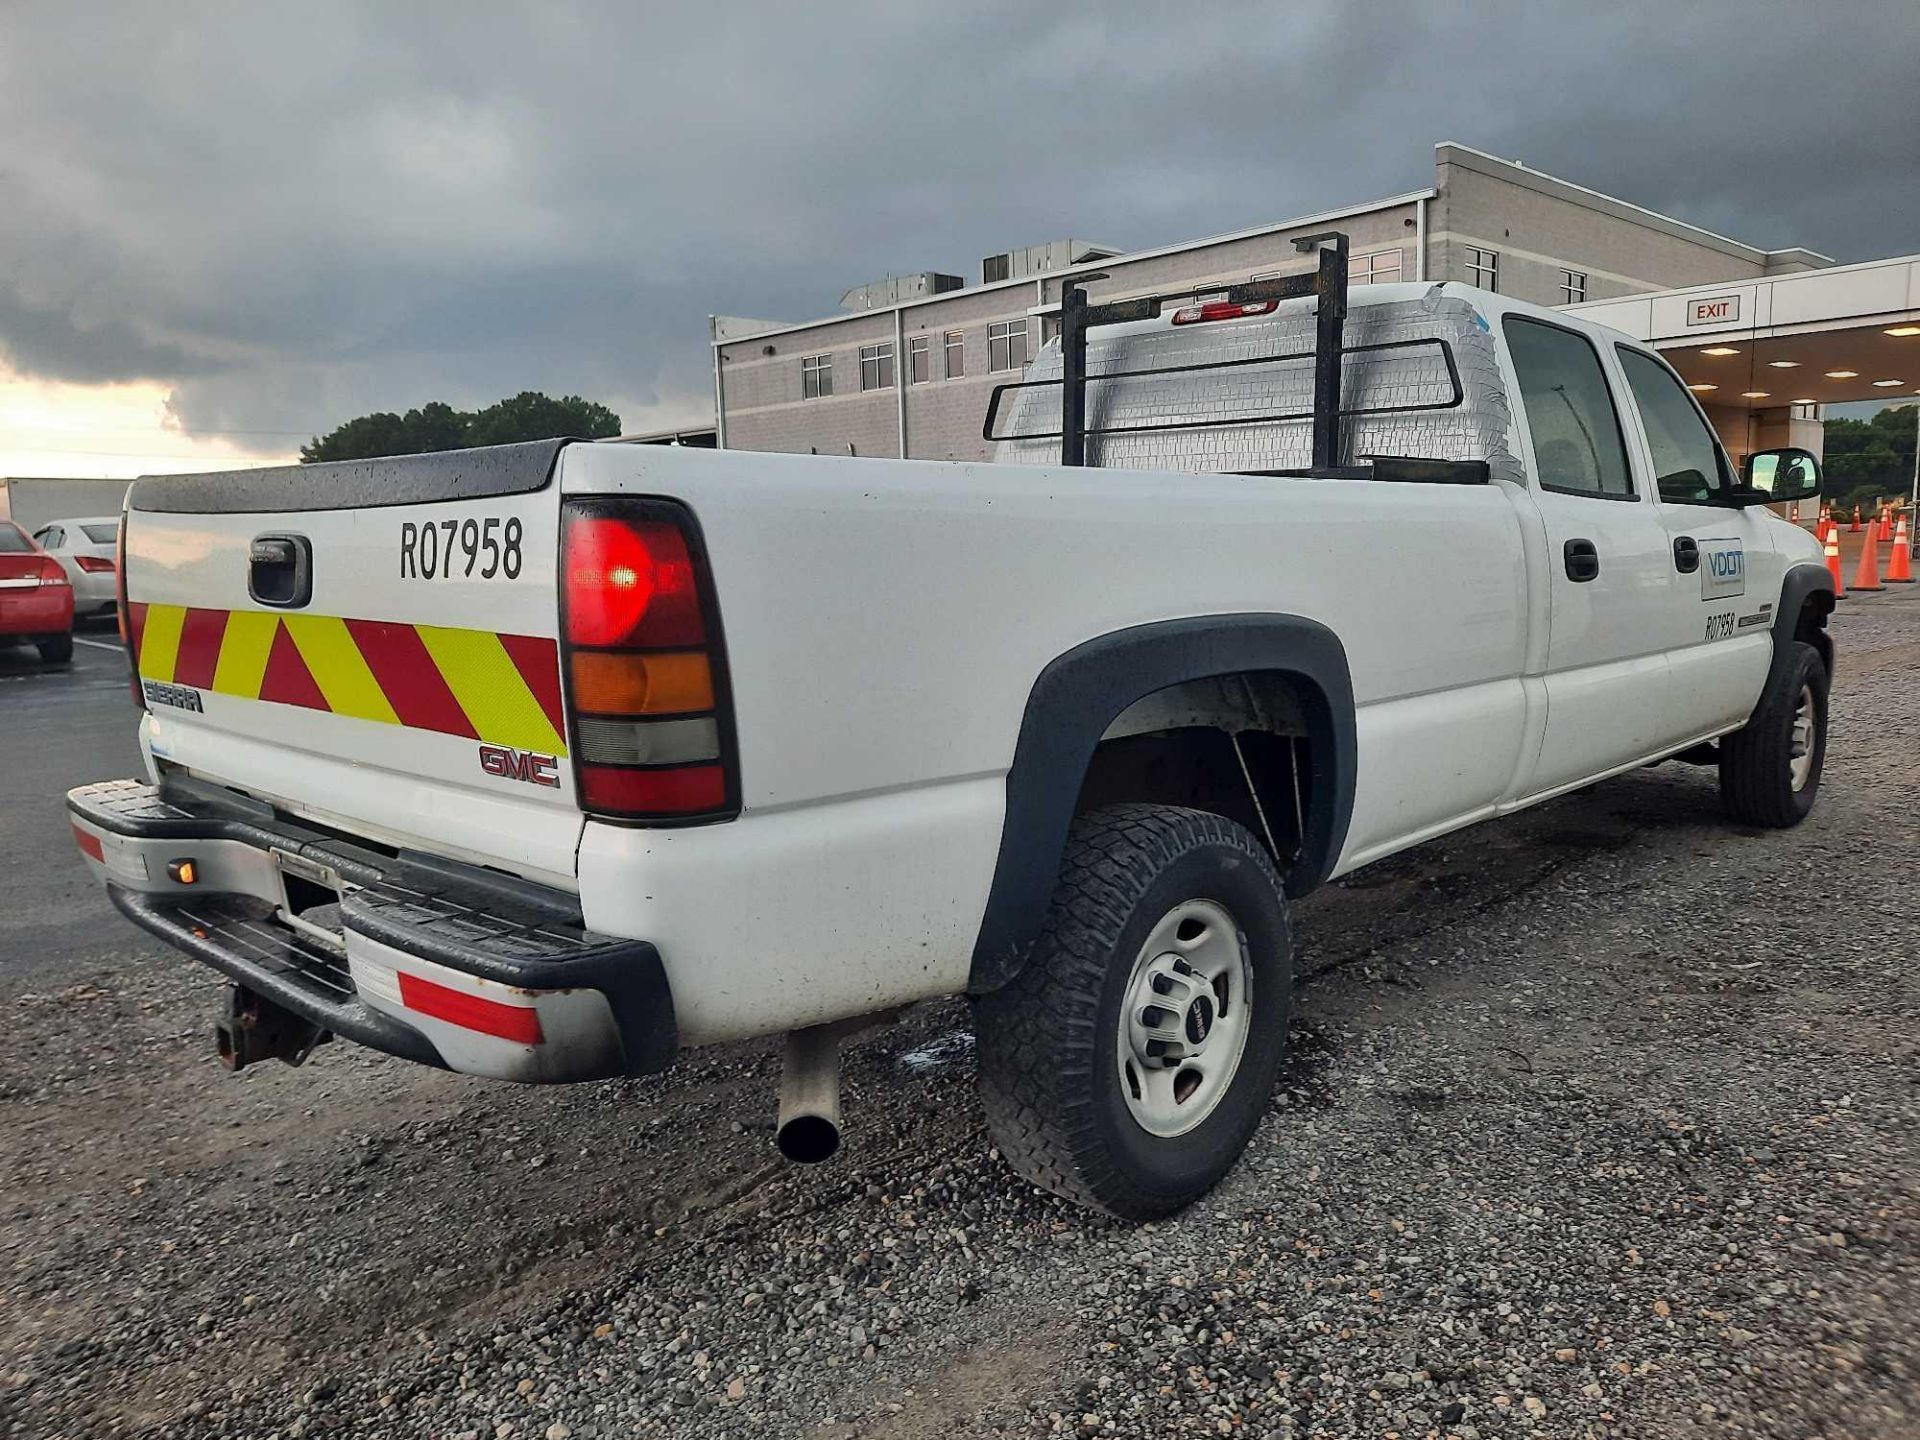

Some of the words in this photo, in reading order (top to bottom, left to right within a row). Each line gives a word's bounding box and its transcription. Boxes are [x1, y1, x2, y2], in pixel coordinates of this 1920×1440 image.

[1697, 303, 1730, 319] EXIT
[401, 517, 522, 580] R07958
[1708, 551, 1744, 576] VDOT
[144, 682, 204, 713] SIERRA
[479, 742, 561, 789] GMC
